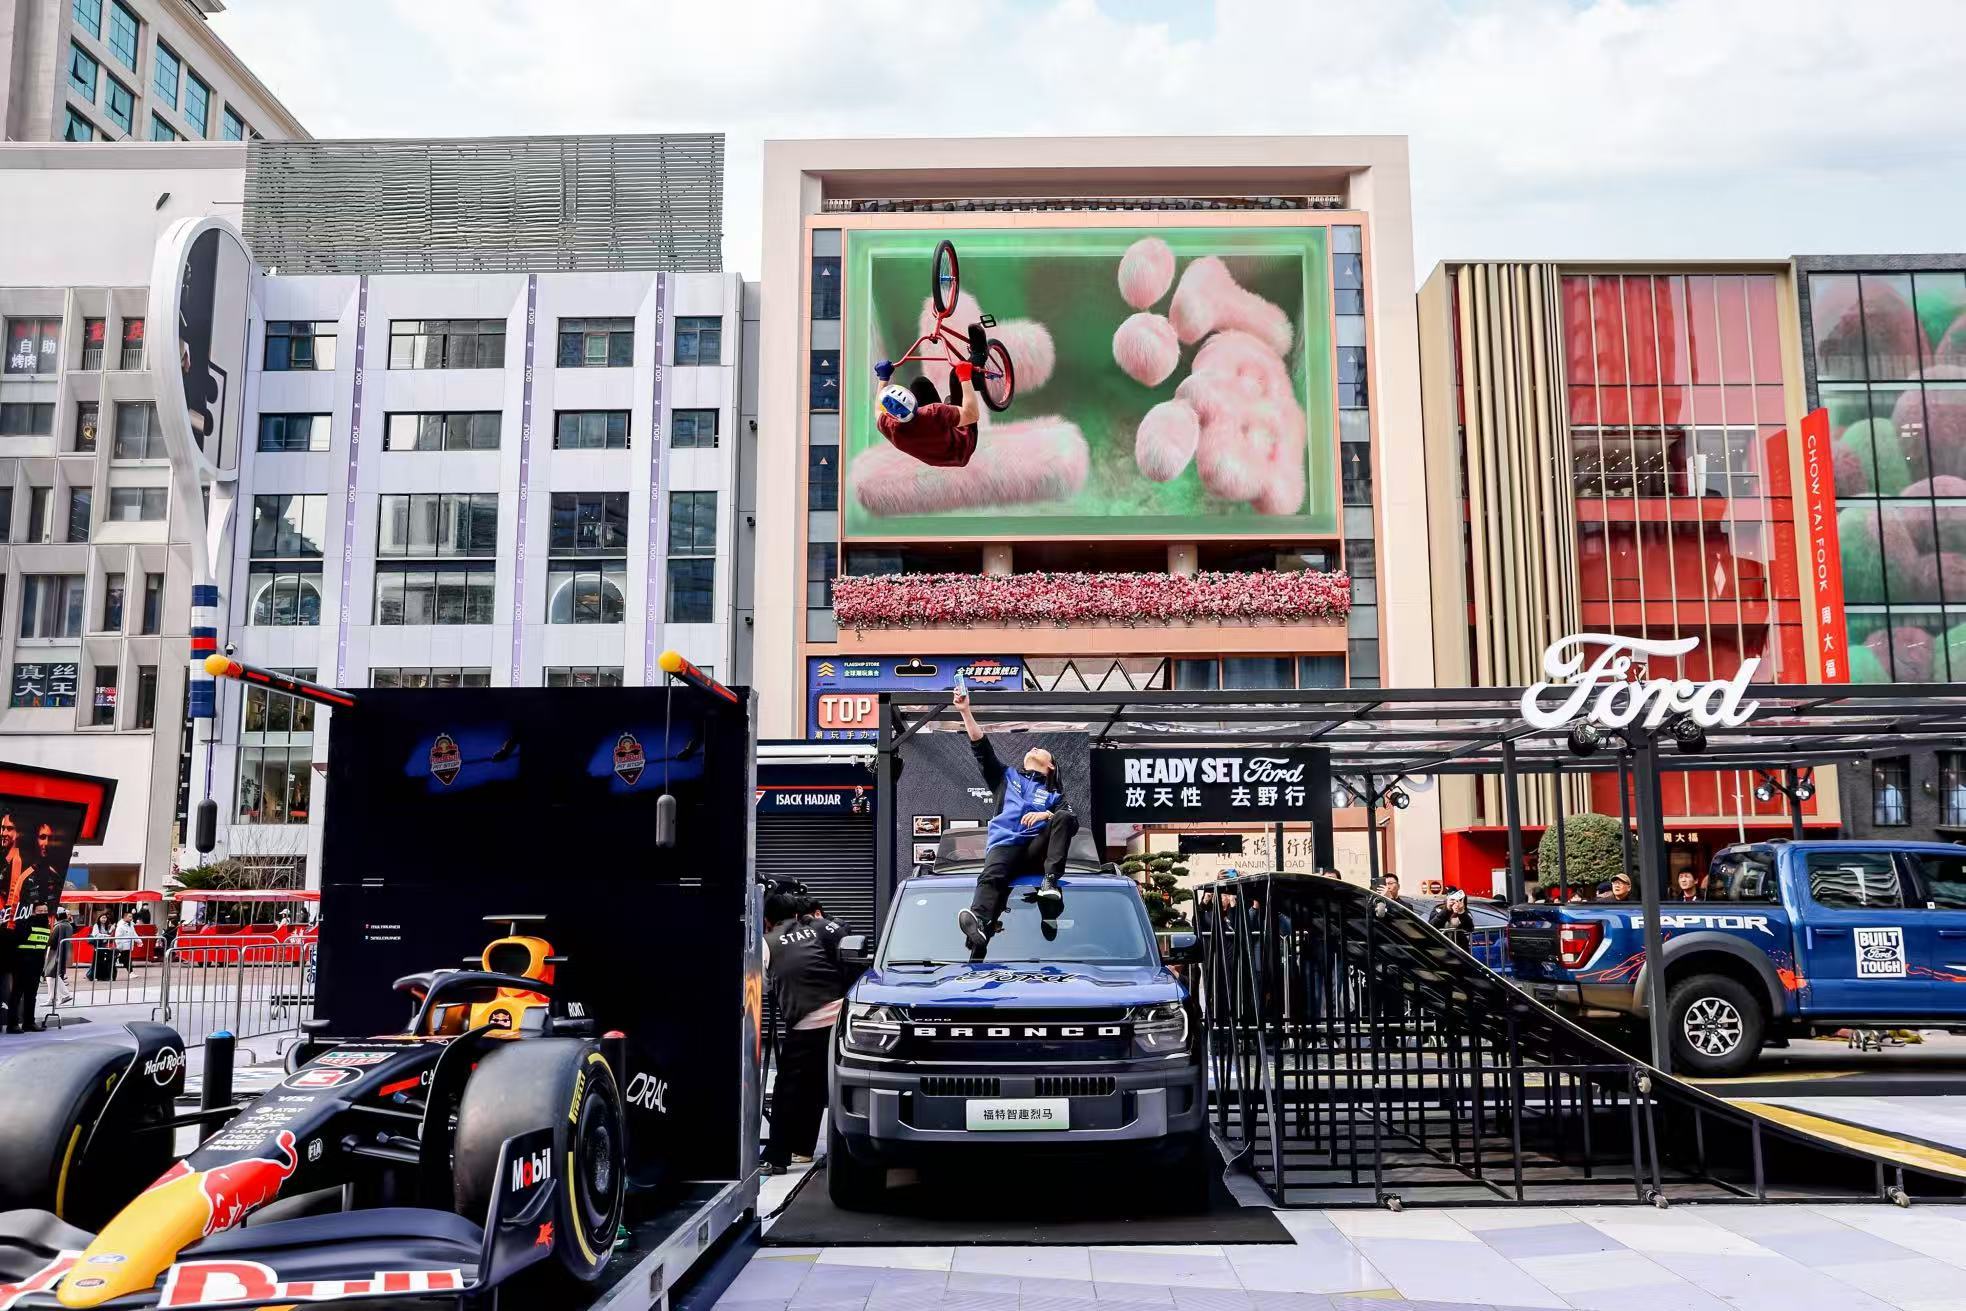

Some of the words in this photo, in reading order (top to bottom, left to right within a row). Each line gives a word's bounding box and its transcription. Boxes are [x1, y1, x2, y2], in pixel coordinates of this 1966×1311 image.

[20, 339, 56, 354] 自助
[11, 354, 37, 368] 烤肉
[348, 484, 356, 502] GOLF
[355, 367, 363, 385] GOLF
[359, 310, 367, 327] GOLF
[1807, 435, 1820, 495] CHOW
[1813, 504, 1823, 531] TAI
[517, 542, 525, 560] GOLF
[1816, 540, 1828, 592] FOOK
[1821, 606, 1836, 678] 周大福
[17, 665, 77, 680] 真丝
[956, 667, 1019, 676] 全球首家旗舰店
[14, 682, 76, 696] 大王
[1520, 633, 1761, 730] Ford
[822, 697, 872, 723] TOP
[1124, 758, 1198, 783] READY
[1201, 757, 1243, 783] SET
[1244, 757, 1305, 783] Ford
[776, 794, 802, 805] ISACK
[804, 794, 841, 805] HADJAR
[1125, 787, 1201, 807] 放天性
[1231, 786, 1305, 807] 去野行
[1664, 832, 1699, 842] 周大福
[1235, 860, 1276, 868] NANJING
[1859, 932, 1898, 947] BUILT
[1867, 948, 1893, 959] Ford
[1861, 961, 1901, 973] TOUGH
[956, 969, 1080, 983] Ford
[914, 1027, 1121, 1037] BRONCO
[144, 1056, 166, 1075] Hard
[166, 1051, 186, 1071] Rock
[983, 1108, 1053, 1120] 福特智趣烈马
[512, 1147, 551, 1192] Mobil
